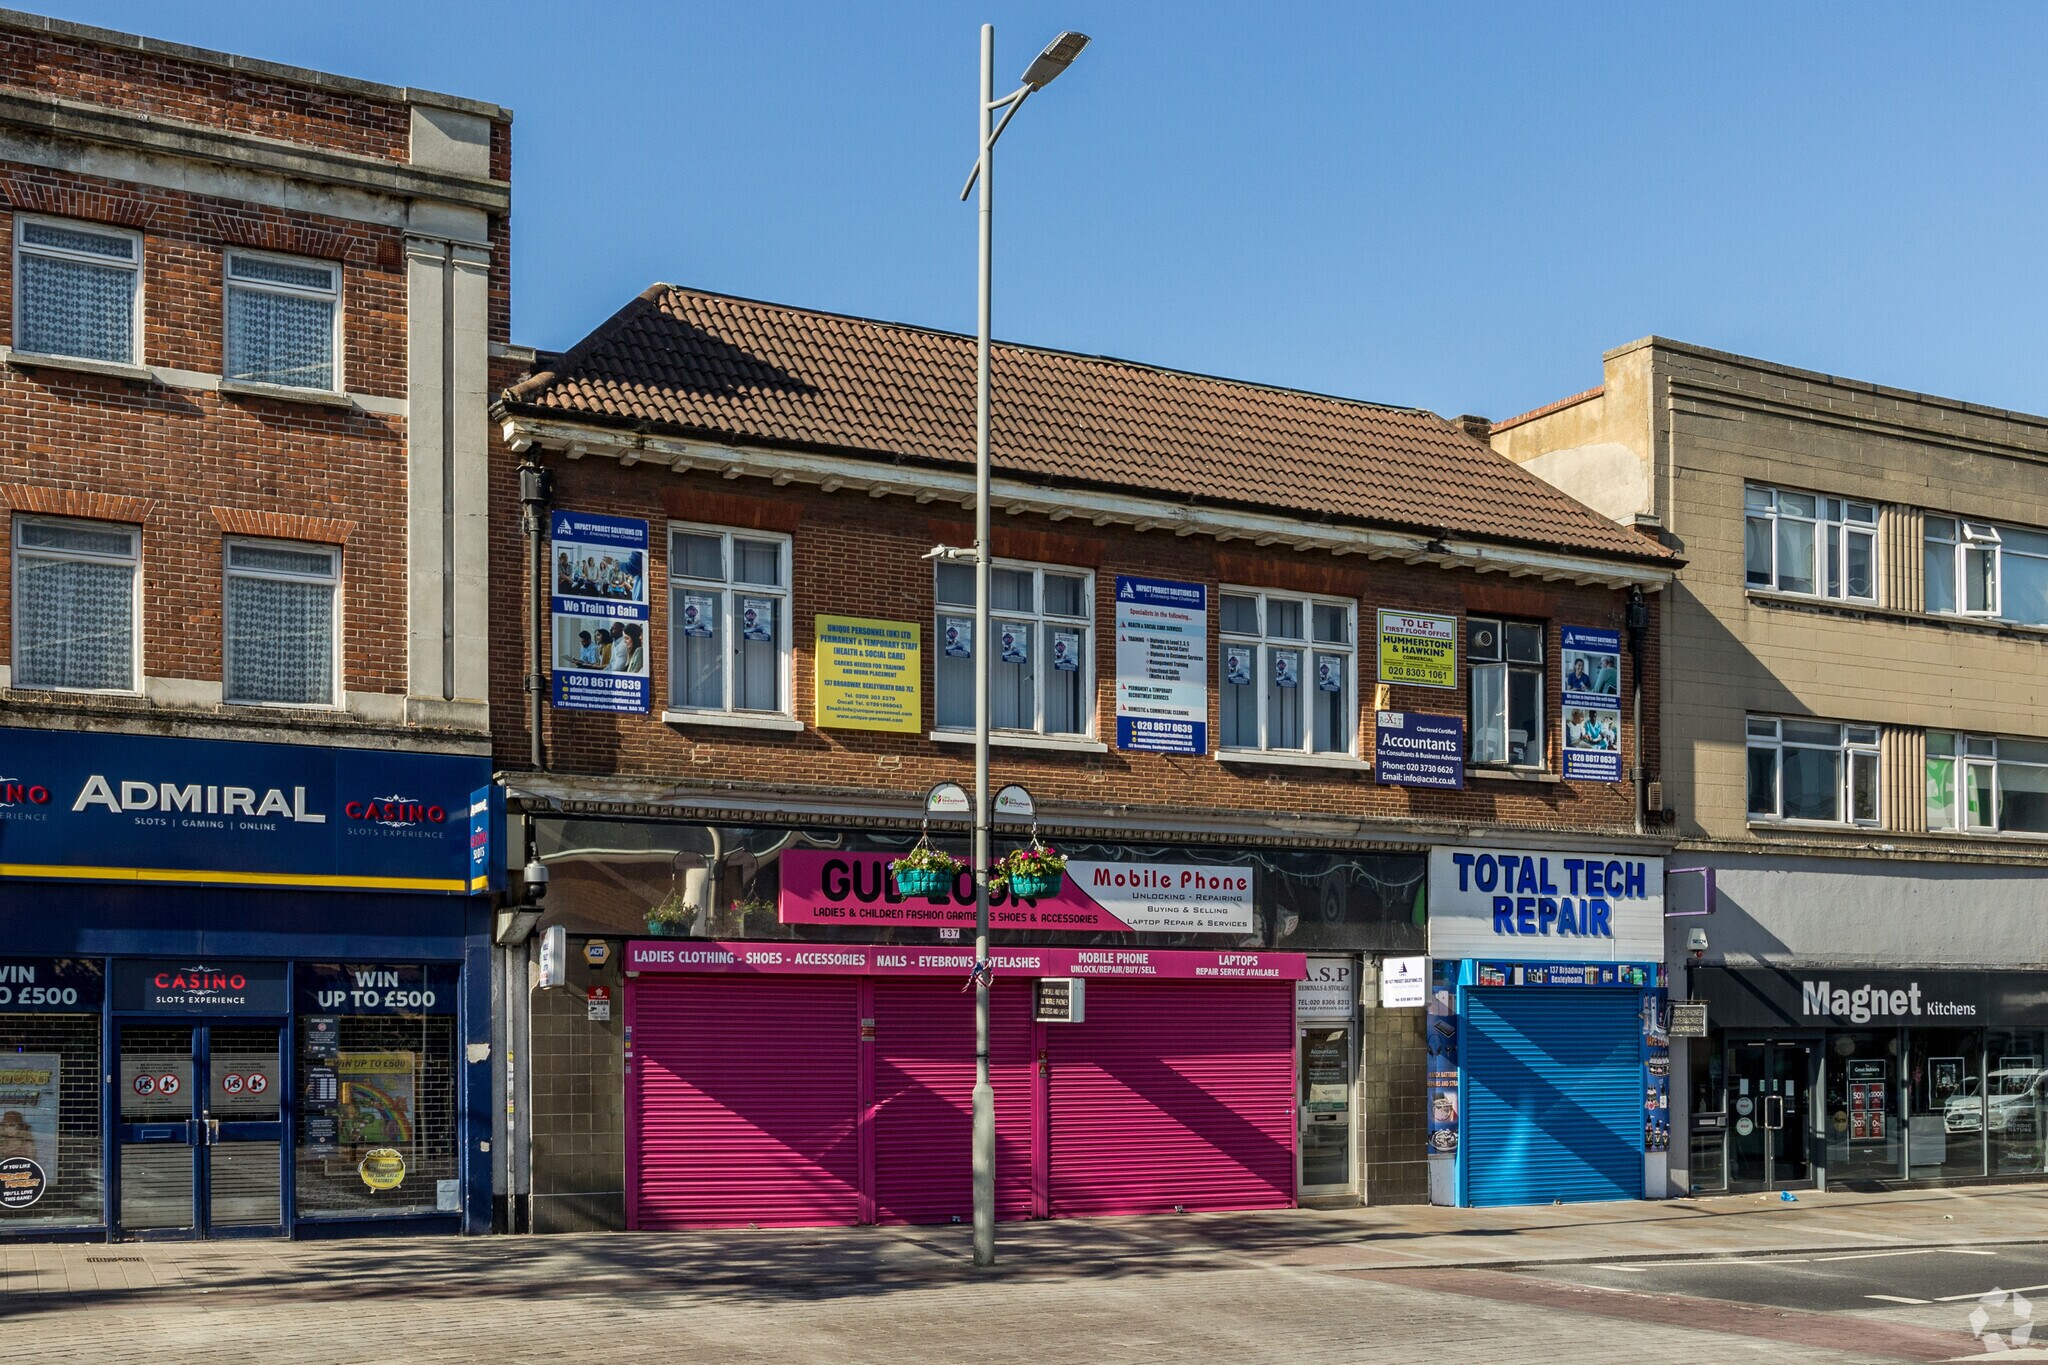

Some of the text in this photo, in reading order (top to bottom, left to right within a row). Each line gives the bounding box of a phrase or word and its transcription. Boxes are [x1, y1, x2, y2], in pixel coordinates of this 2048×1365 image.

[574, 522, 591, 531] IMPACT
[591, 524, 610, 533] PROJECT
[611, 526, 634, 536] SOLUTIONS
[635, 529, 643, 537] LTD
[563, 600, 638, 618] We Train to Gain
[1130, 608, 1154, 617] Specialists
[1401, 618, 1435, 629] TO LET
[827, 624, 850, 634] UNIQUE
[851, 627, 885, 636] PERSONNEL
[901, 630, 911, 640] LTD
[1406, 628, 1427, 636] FLOOR
[1428, 630, 1450, 638] OFFICE
[820, 635, 856, 645] PERMANENT
[864, 638, 900, 648] TEMPORARY
[900, 642, 918, 650] STAFF
[1383, 635, 1454, 650] HUMMERSTONE
[864, 650, 886, 658] SOCIAL
[888, 652, 906, 660] CARE)
[1392, 644, 1445, 657] & HAWKINS
[1388, 666, 1447, 680] 020 8303 1061
[570, 676, 642, 690] 020 8617 0639
[1137, 720, 1192, 734] 020 8617 0639
[1416, 726, 1438, 734] Chartered
[1382, 733, 1456, 752] Accountants
[1377, 748, 1386, 756] Tax
[1386, 750, 1414, 758] Consultants
[1420, 752, 1440, 760] Business
[1441, 754, 1462, 762] Advisors
[1572, 754, 1584, 762] 020
[1585, 754, 1600, 763] 8617
[1382, 761, 1454, 774] Phone: 020 3730 6626
[1382, 772, 1456, 785] Email: info@acxit.co.uk
[72, 774, 326, 824] ADMIRAL
[345, 801, 446, 823] CASINO
[134, 816, 277, 831] SLOTS GAMING ONLINE
[348, 827, 445, 839] SLOTS EXPERIENCE
[1093, 868, 1248, 890] Mobile Phone
[1452, 852, 1646, 900] TOTAL TECH
[1132, 892, 1243, 902] UNLOCKING REPAIRING
[813, 906, 1098, 924] LADIES & CHILDREN FASHION GARMES SHOES & ACCESSORIES
[1147, 906, 1228, 914] BUYING & SELLING
[1492, 896, 1612, 938] REPAIR
[1127, 918, 1161, 926] LAPTOP
[1207, 920, 1248, 928] SERVICES
[940, 929, 959, 938] 137
[590, 948, 604, 956] ADT
[634, 950, 866, 966] LADIES CLOTHING SHOES ACCESSORIES
[1078, 952, 1148, 964] MOBILE PHONE
[876, 955, 1041, 969] NAILS EYEBROWS YELASHES
[1218, 955, 1258, 966] LAPTOPS
[1070, 965, 1157, 974] UNLOCK/REPAIR/BUY/SELL
[1196, 967, 1279, 977] REPAIR SERVICE AVAILABLE
[1550, 966, 1584, 976] 137 Broadway
[154, 973, 246, 990] CASINO
[355, 971, 398, 988] WIN
[1551, 976, 1583, 984] Bexleyheath
[18, 986, 78, 1006] £500
[156, 996, 246, 1005] SLOTS EXPERIENCE
[318, 990, 436, 1008] UP TO £500
[1802, 981, 1976, 1024] Magnet Kitchens
[354, 1060, 367, 1068] UP
[370, 1059, 382, 1068] TO
[384, 1059, 406, 1068] £500
